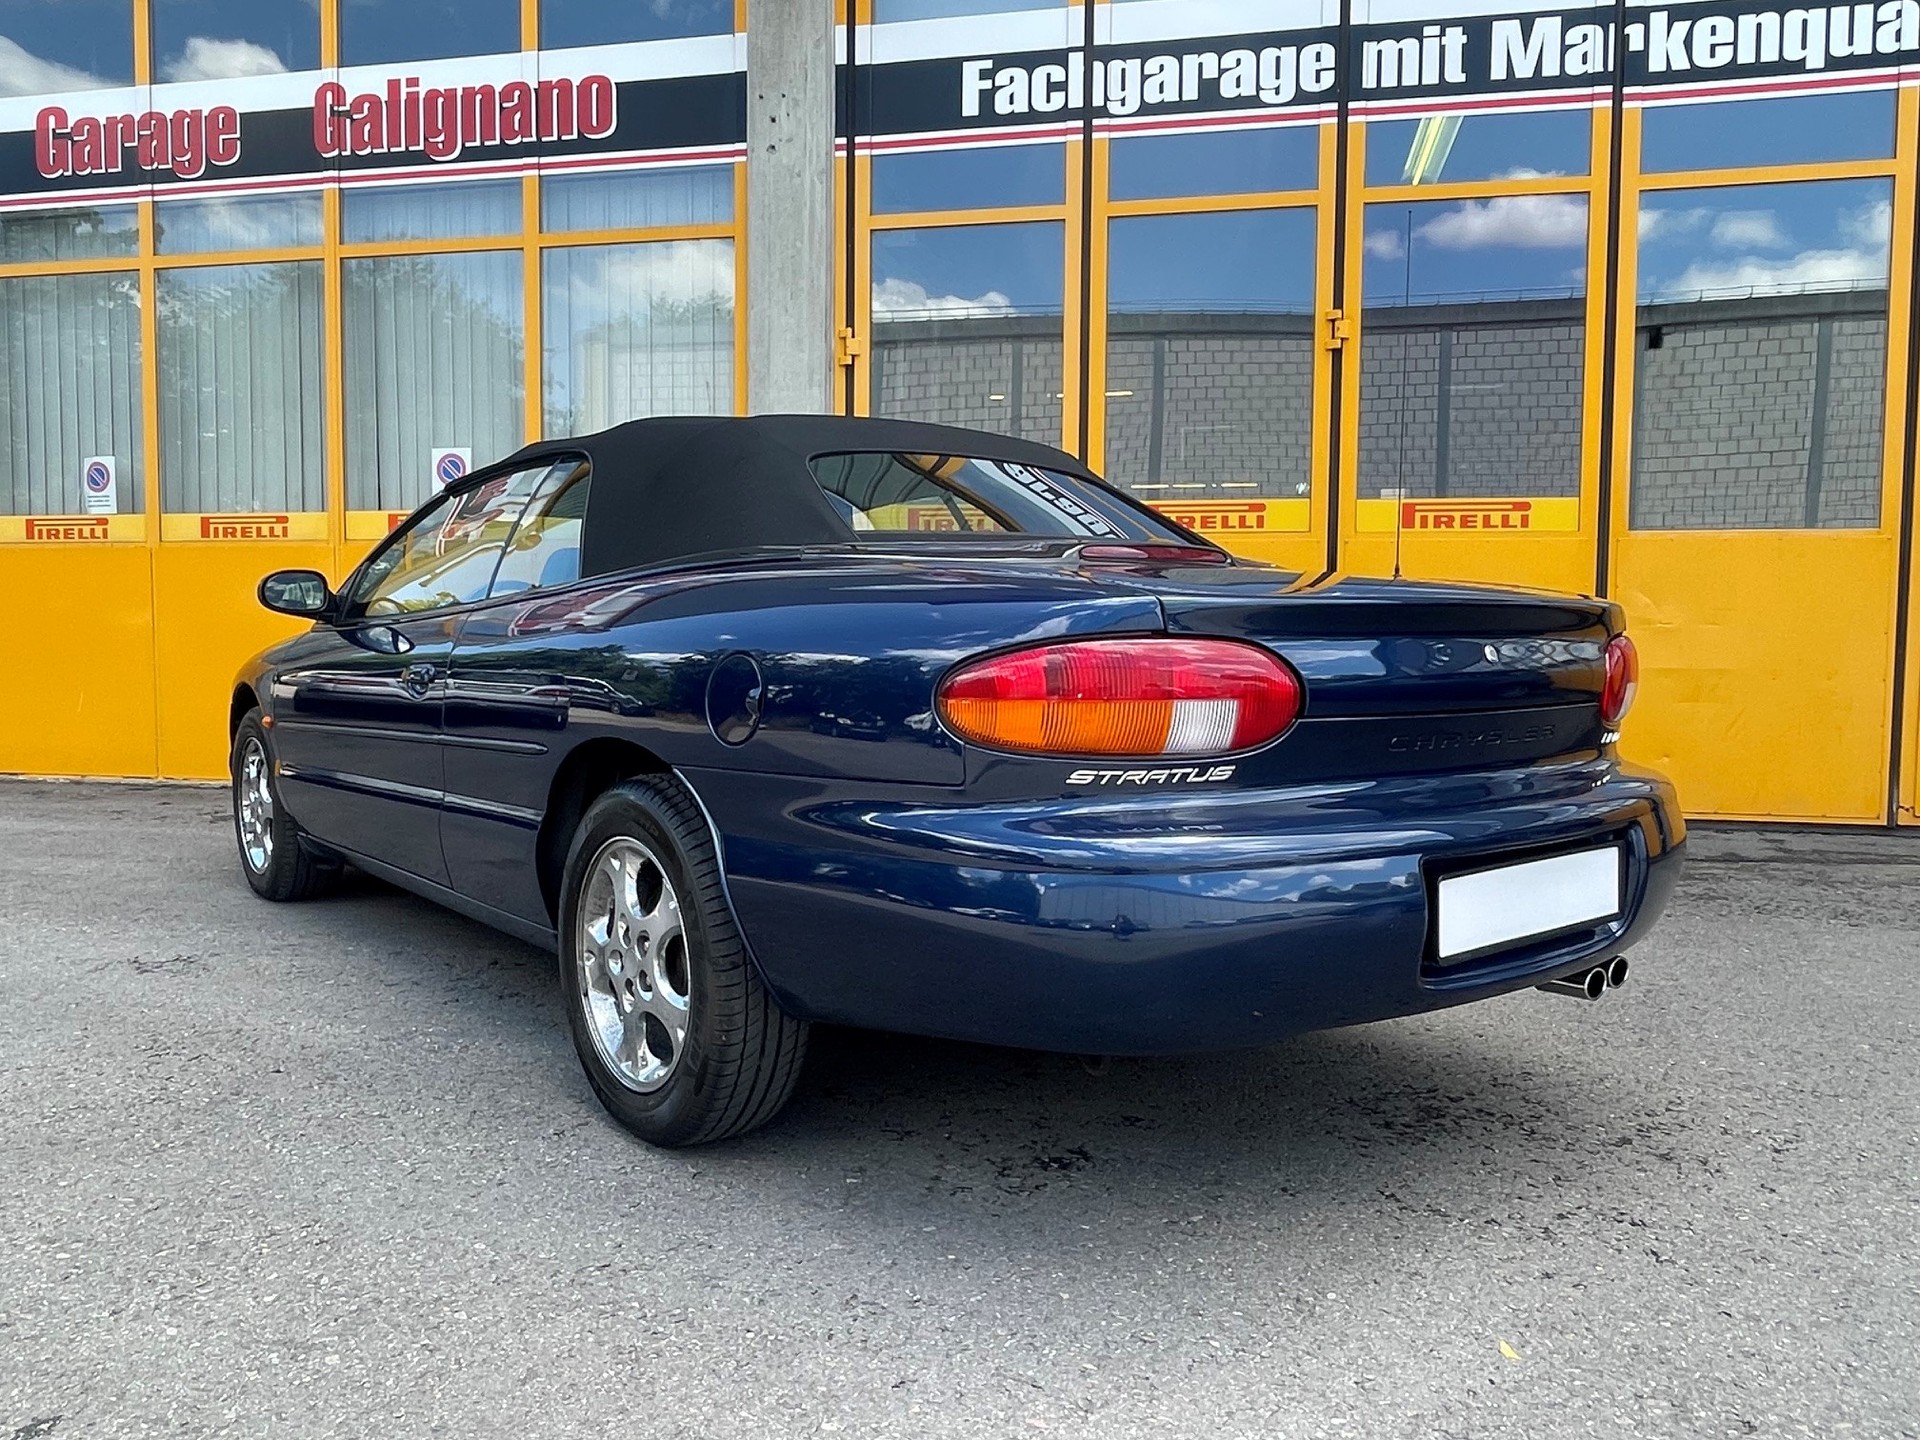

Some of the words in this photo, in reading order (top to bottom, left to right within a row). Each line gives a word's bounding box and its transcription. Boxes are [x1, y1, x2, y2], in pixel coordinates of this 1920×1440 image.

[960, 39, 1337, 117] Fachgarage
[1361, 25, 1467, 89] mit
[35, 105, 242, 179] Garage
[313, 74, 618, 162] Galignano
[201, 515, 289, 539] PIRELLI
[1402, 501, 1532, 529] PIRELLI
[25, 518, 109, 540] PIRELLI
[1388, 725, 1555, 752] CHRYSLER
[1065, 765, 1236, 785] STRATUS
